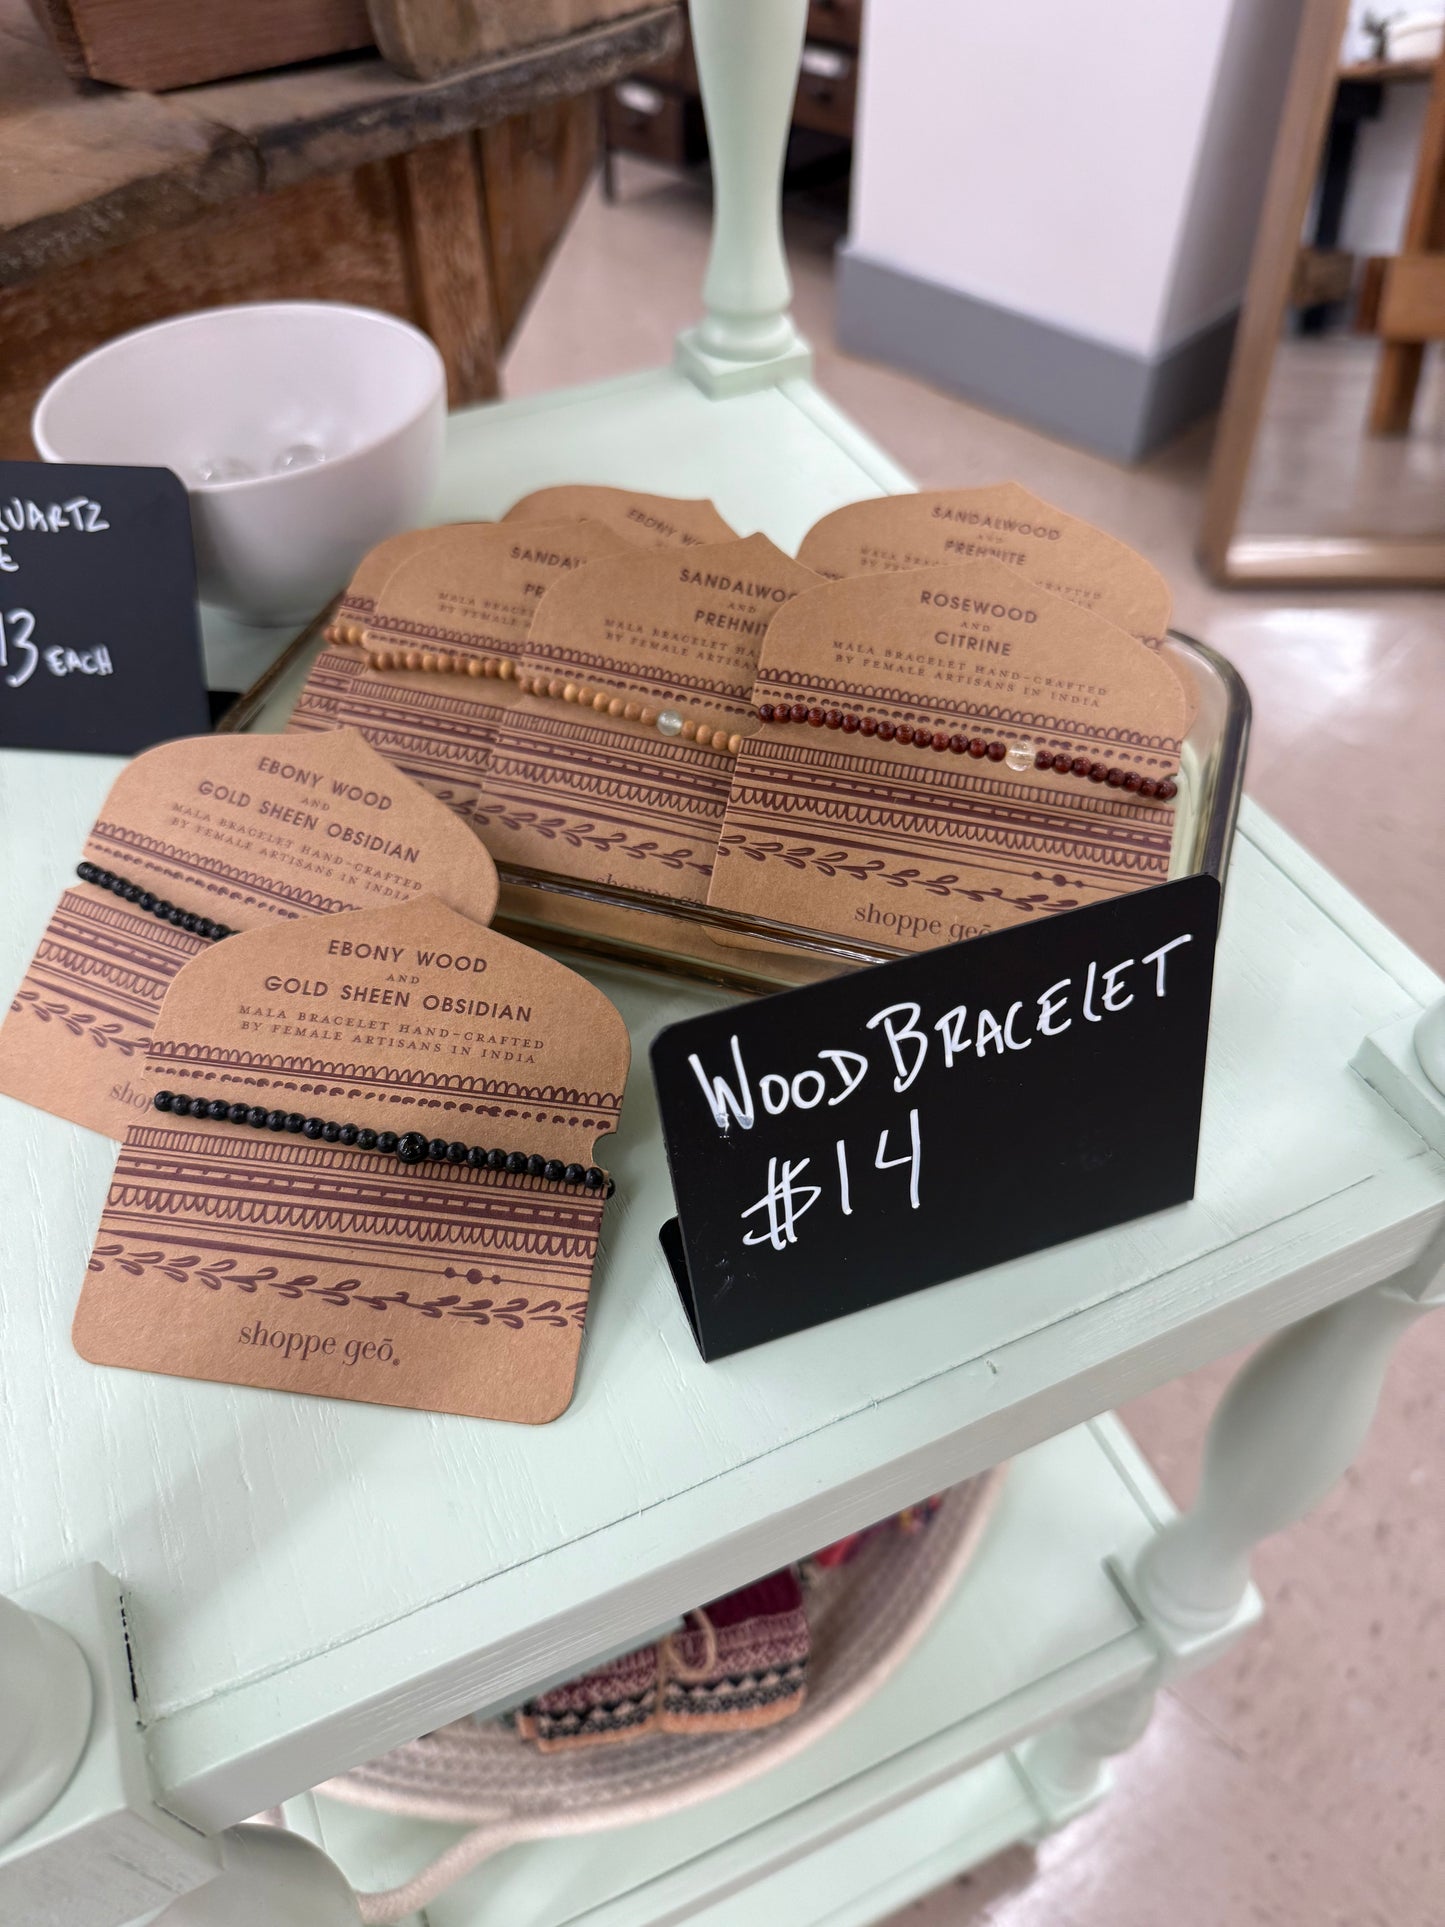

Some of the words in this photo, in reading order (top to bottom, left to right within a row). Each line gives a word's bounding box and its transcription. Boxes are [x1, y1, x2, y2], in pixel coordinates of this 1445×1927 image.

[931, 506, 1062, 541] SANDALWOOD
[920, 590, 1038, 624] ROSEWOOD
[960, 620, 991, 633] AND
[44, 645, 113, 677] EACH
[934, 631, 1013, 657] CITRINE
[833, 640, 875, 656] MALA
[884, 648, 967, 672] BRACELET
[976, 665, 1108, 696] HAND-CRAFTED
[835, 653, 854, 665] BY
[862, 658, 926, 677] FEMALE
[934, 671, 1015, 693] ARTISANS
[1023, 686, 1042, 697] IN
[1050, 691, 1101, 708] INDIA
[258, 756, 324, 788] EBONY
[332, 780, 392, 810] WOOD
[301, 797, 330, 811] AND
[198, 780, 251, 807] GOLD
[259, 800, 319, 830] SHEEN
[327, 823, 420, 863] OBSIDIAN
[171, 817, 190, 829] BY
[196, 825, 253, 850] FEMALE
[259, 847, 334, 877] ARTISANS
[341, 873, 359, 885] IN
[172, 802, 211, 822] MALA
[219, 818, 295, 849] BRACELET
[301, 845, 423, 891] HAND-CRAFTED
[854, 902, 942, 939] shoppe
[328, 939, 404, 963] EBONY
[416, 950, 488, 973] WOOD
[264, 975, 329, 997] GOLD
[340, 984, 411, 1008] SHEEN
[423, 994, 532, 1023] OBSIDIAN
[385, 974, 420, 985] AND
[239, 1005, 287, 1019] MALA
[297, 1012, 390, 1031] BRACELET
[399, 1024, 545, 1050] HAND-CRAFTED
[241, 1020, 263, 1031] BY
[271, 1024, 344, 1041] FEMALE
[352, 1034, 442, 1053] ARTISANS
[451, 1045, 472, 1056] IN
[481, 1048, 536, 1064] INDIA
[688, 1035, 869, 1130] WOOD
[866, 933, 1194, 1093] BRACELET
[741, 1109, 922, 1250] $14
[238, 1320, 337, 1361] shoppe
